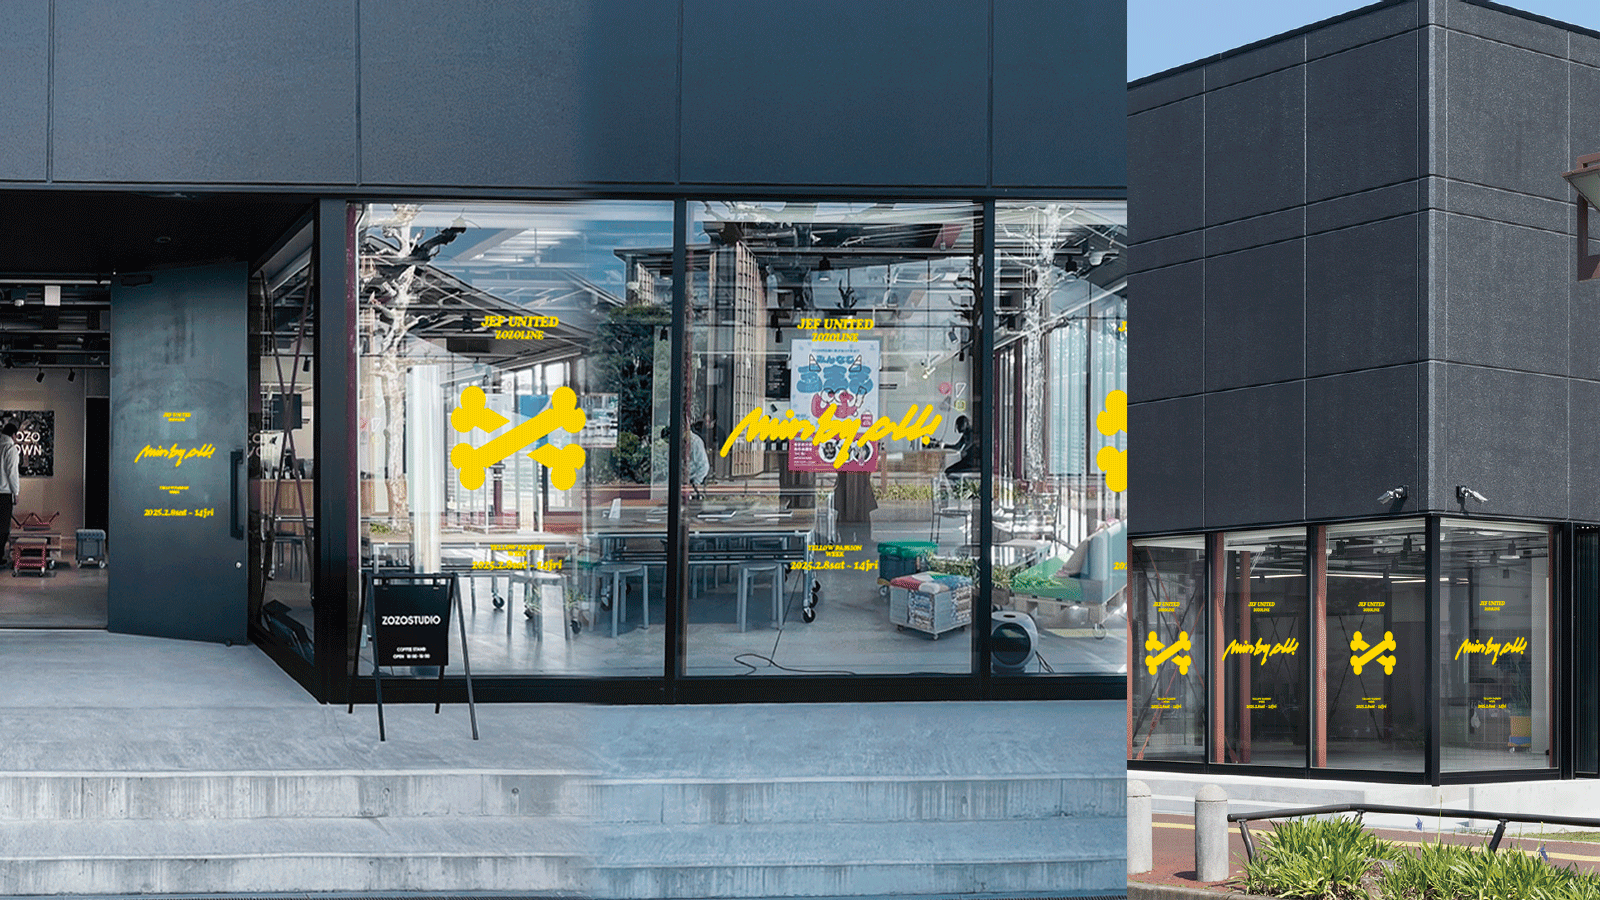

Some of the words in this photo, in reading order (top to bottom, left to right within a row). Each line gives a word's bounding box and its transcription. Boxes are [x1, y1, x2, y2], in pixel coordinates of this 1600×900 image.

[481, 316, 506, 328] JEF
[508, 316, 559, 328] UNITED
[797, 318, 821, 330] JEF
[824, 318, 874, 330] UNITED
[1118, 321, 1127, 332] J
[495, 330, 544, 340] ZOZOLINE
[811, 332, 860, 343] ZOZOLINE
[15, 431, 41, 442] OZO
[854, 559, 879, 572] 14fri
[381, 615, 442, 625] ZOZOSTUDIO
